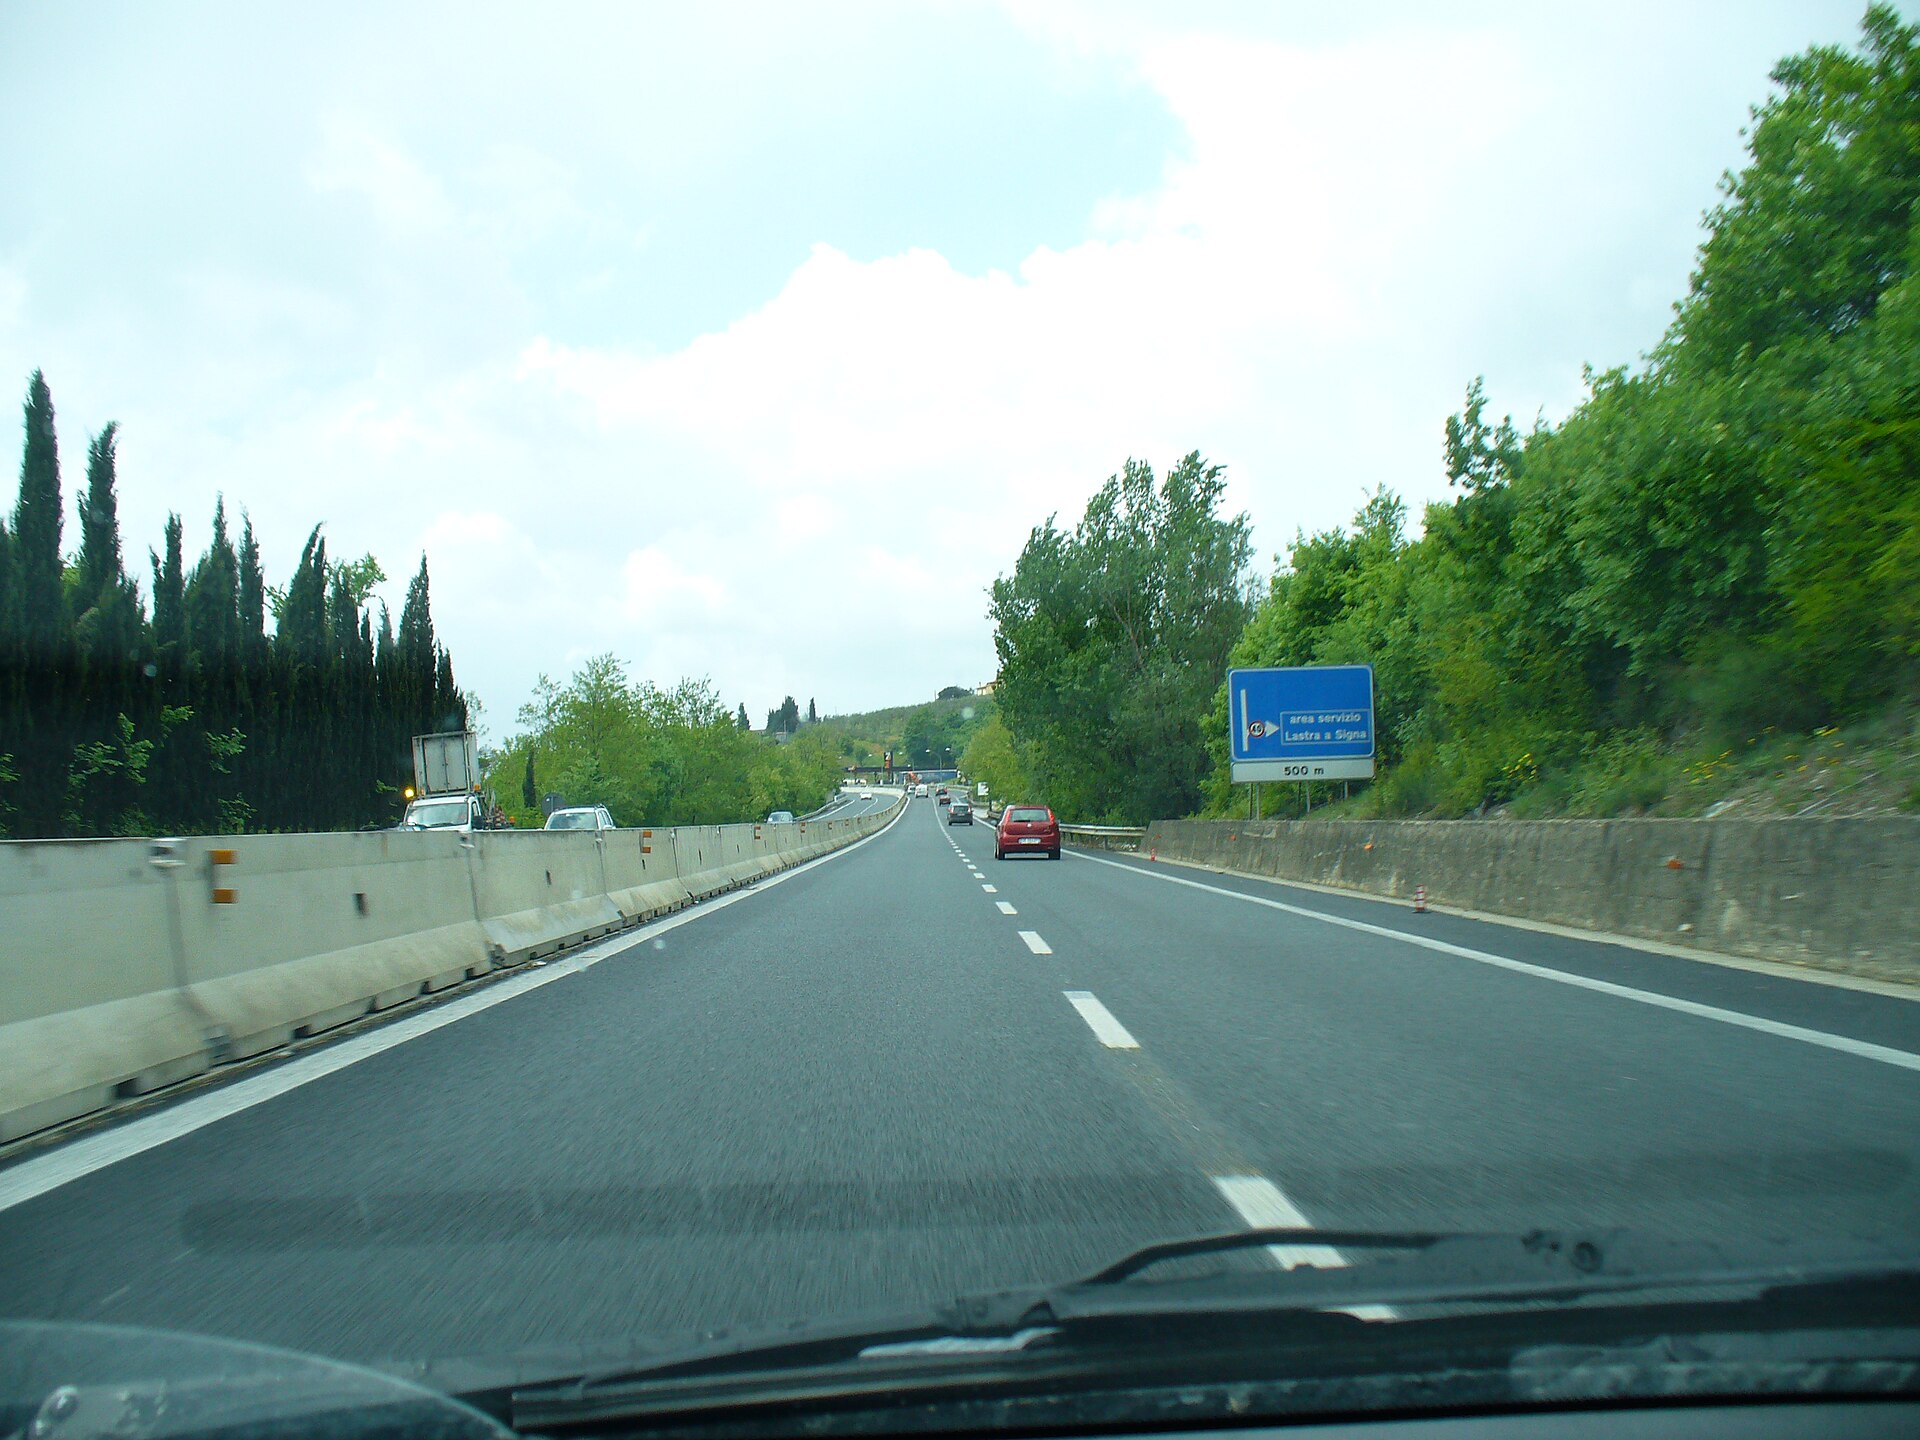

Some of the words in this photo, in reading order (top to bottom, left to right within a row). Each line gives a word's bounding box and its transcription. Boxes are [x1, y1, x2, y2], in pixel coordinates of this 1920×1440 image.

[1290, 715, 1314, 724] area
[1318, 713, 1361, 723] servizio
[1285, 731, 1321, 741] Lastra
[1324, 732, 1331, 740] a
[1335, 730, 1367, 742] Signa
[1284, 766, 1308, 776] 500
[1314, 767, 1324, 775] m
